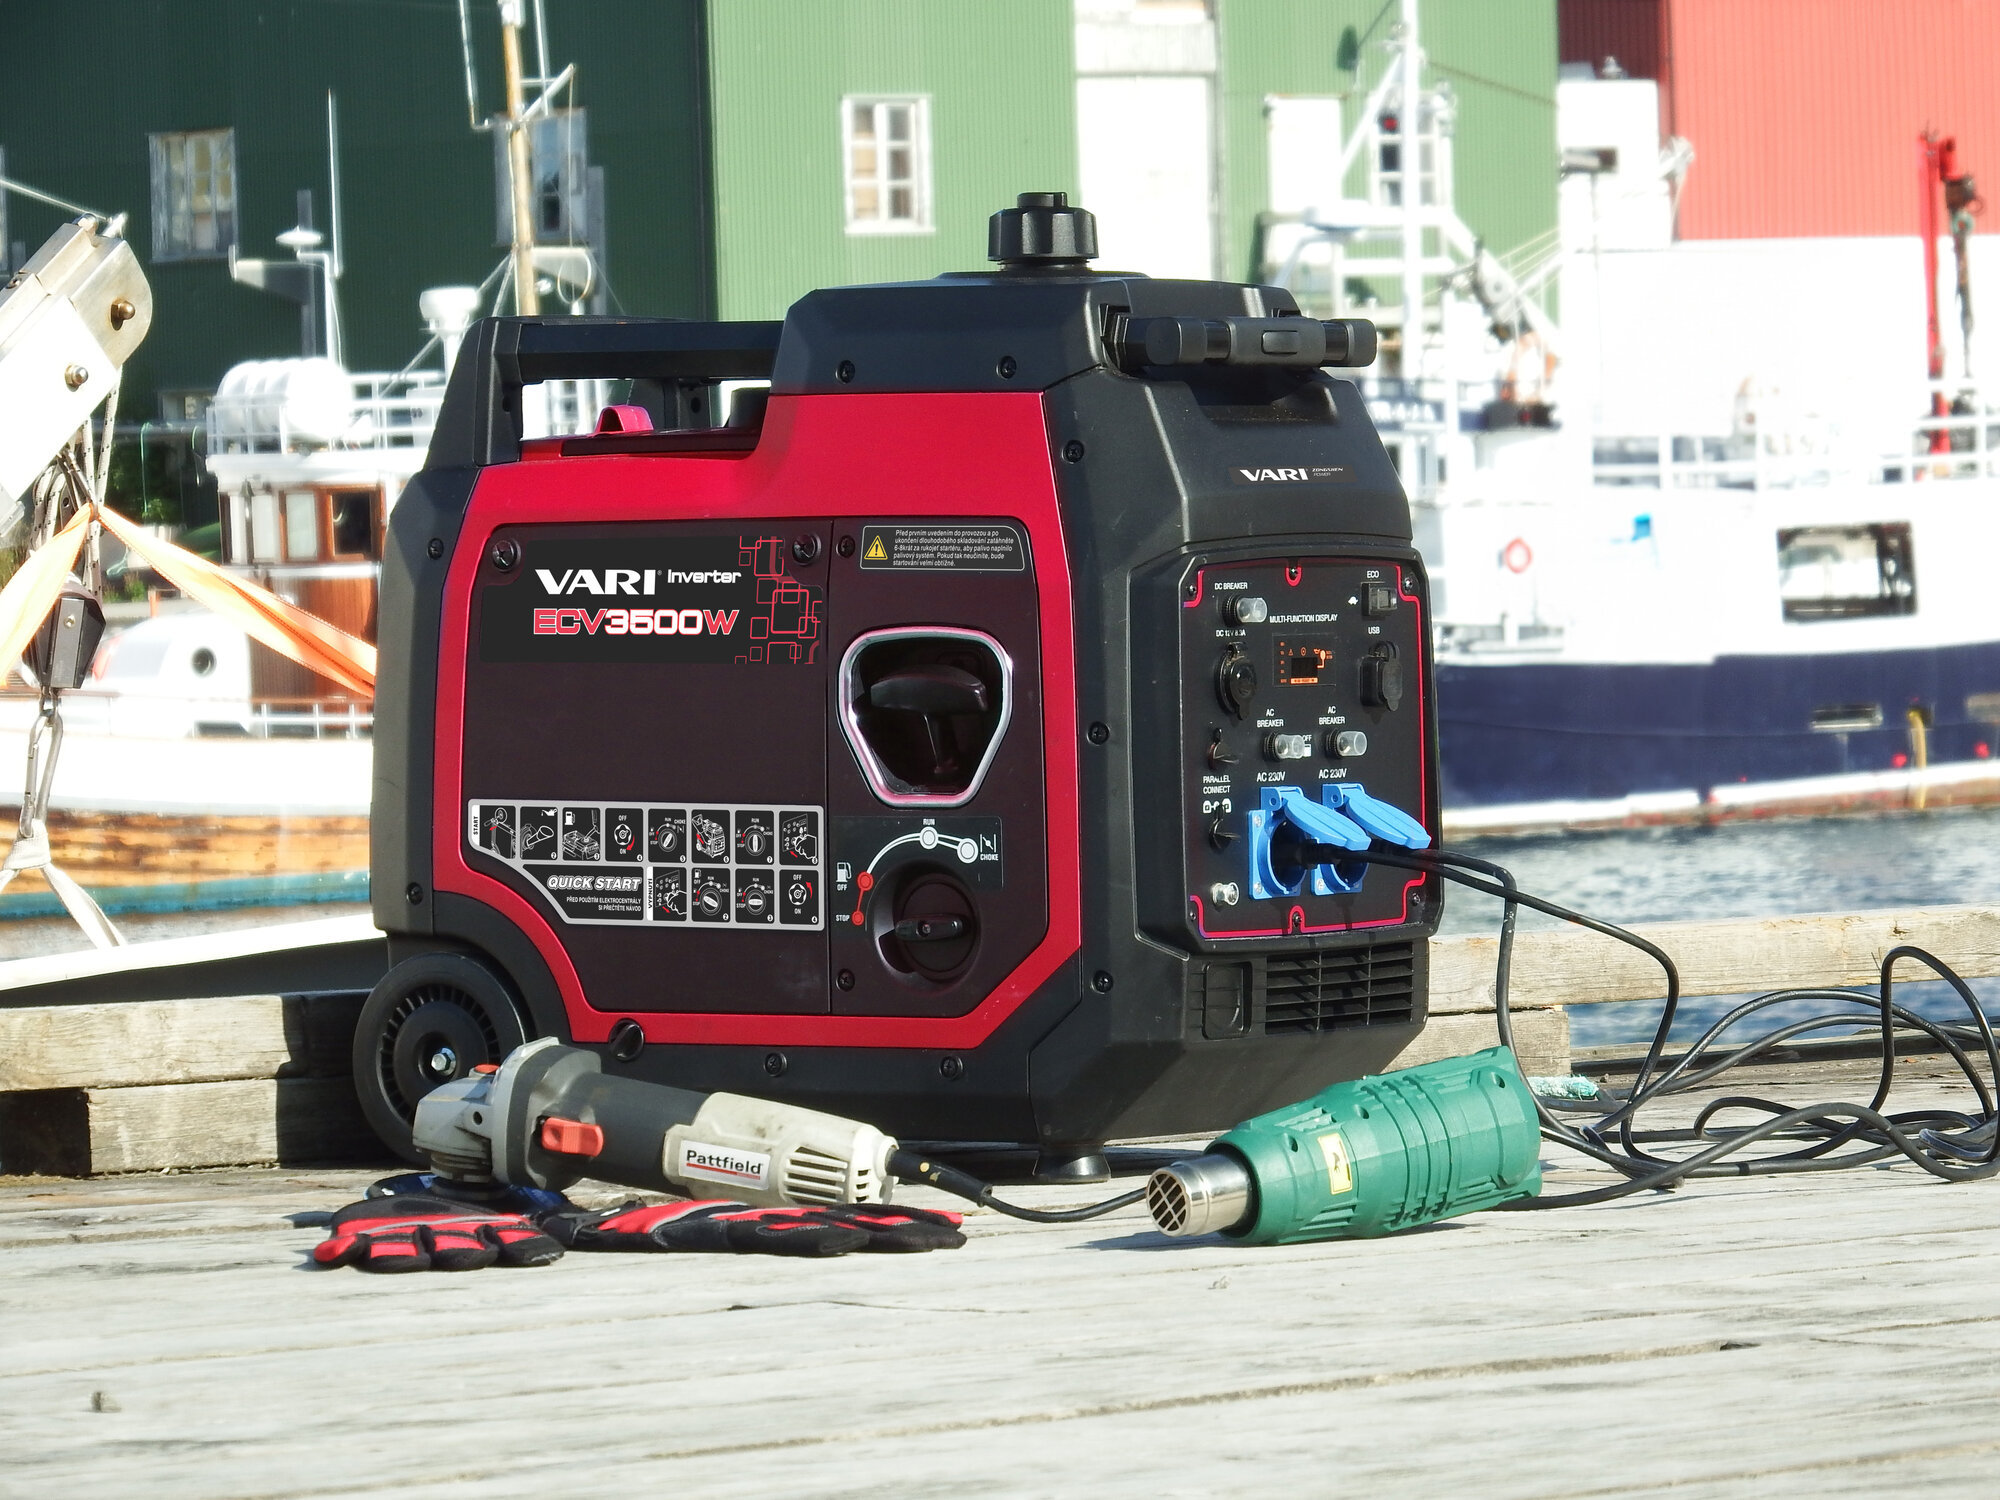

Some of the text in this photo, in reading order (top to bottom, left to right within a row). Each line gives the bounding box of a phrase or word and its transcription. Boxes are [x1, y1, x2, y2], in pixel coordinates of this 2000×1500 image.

[1240, 469, 1308, 481] VARI
[893, 552, 915, 560] palivový
[1366, 570, 1380, 578] ECO
[535, 569, 742, 594] VARI Inverter
[533, 608, 739, 635] ECV3500W
[1269, 614, 1338, 623] MULTI-FUNCTION DISPLAY
[1368, 626, 1380, 634] USB
[1328, 706, 1336, 714] AC
[1256, 719, 1284, 728] BREAKER
[1318, 716, 1345, 725] BREAKER
[1257, 771, 1286, 782] AC 230V
[1318, 768, 1347, 779] AC 230V
[1203, 785, 1230, 794] CONNECT
[547, 875, 642, 891] QUICK START
[686, 1150, 760, 1174] Pattfield
